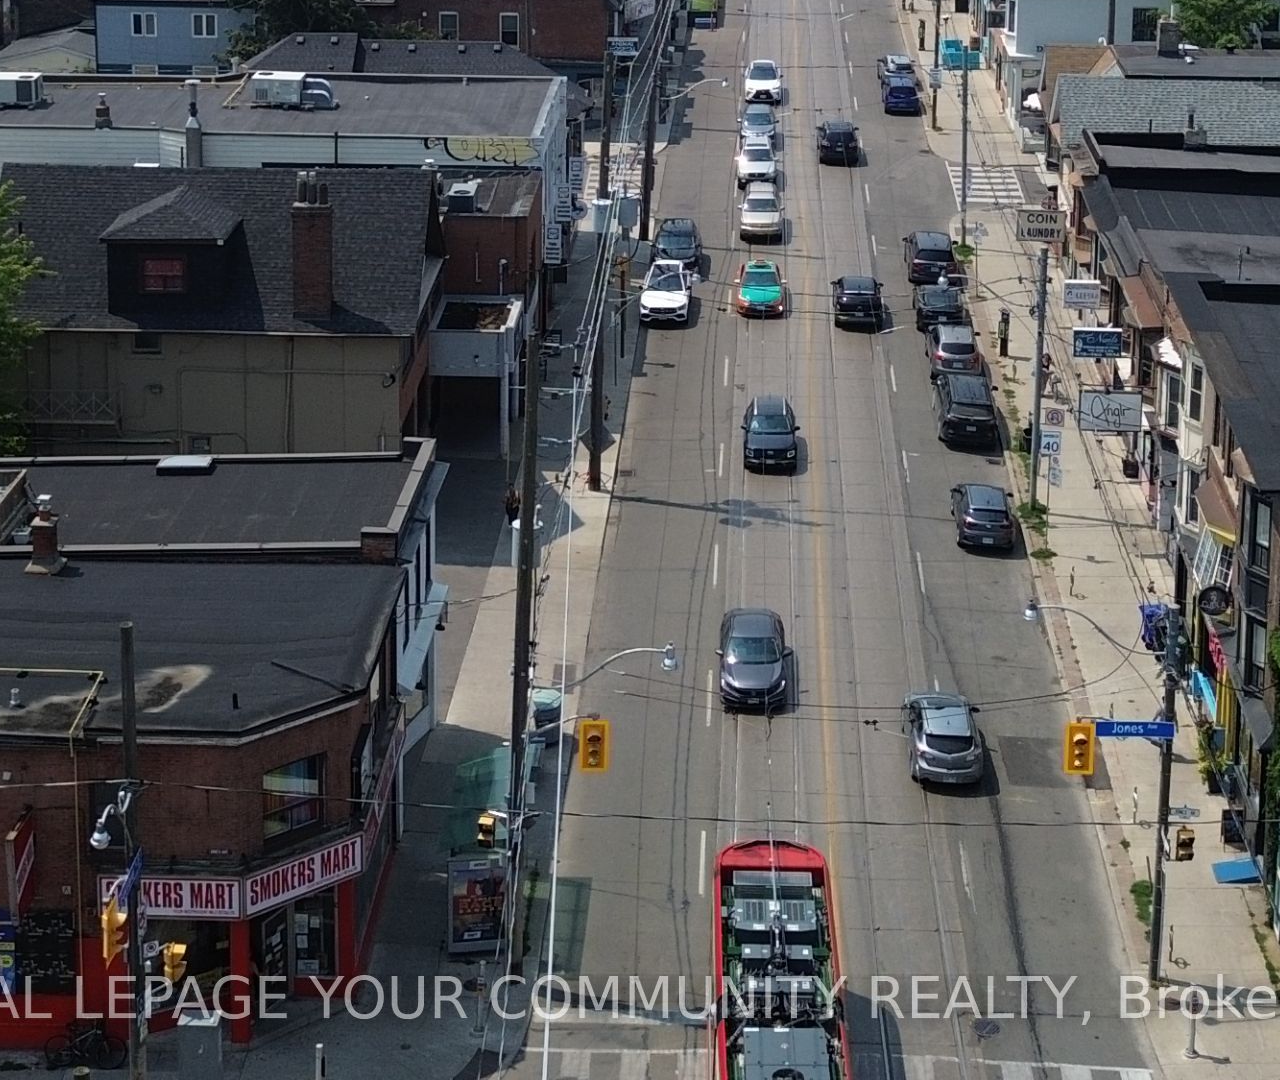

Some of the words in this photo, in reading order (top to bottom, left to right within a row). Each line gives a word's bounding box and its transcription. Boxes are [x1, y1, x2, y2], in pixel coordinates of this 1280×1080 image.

[1027, 213, 1058, 224] COIN
[1021, 228, 1062, 239] LAUNDRY
[1043, 441, 1059, 452] 40
[1111, 722, 1144, 735] Jones
[250, 856, 316, 906] SMOKERS
[321, 840, 358, 879] MART
[190, 883, 235, 910] MART
